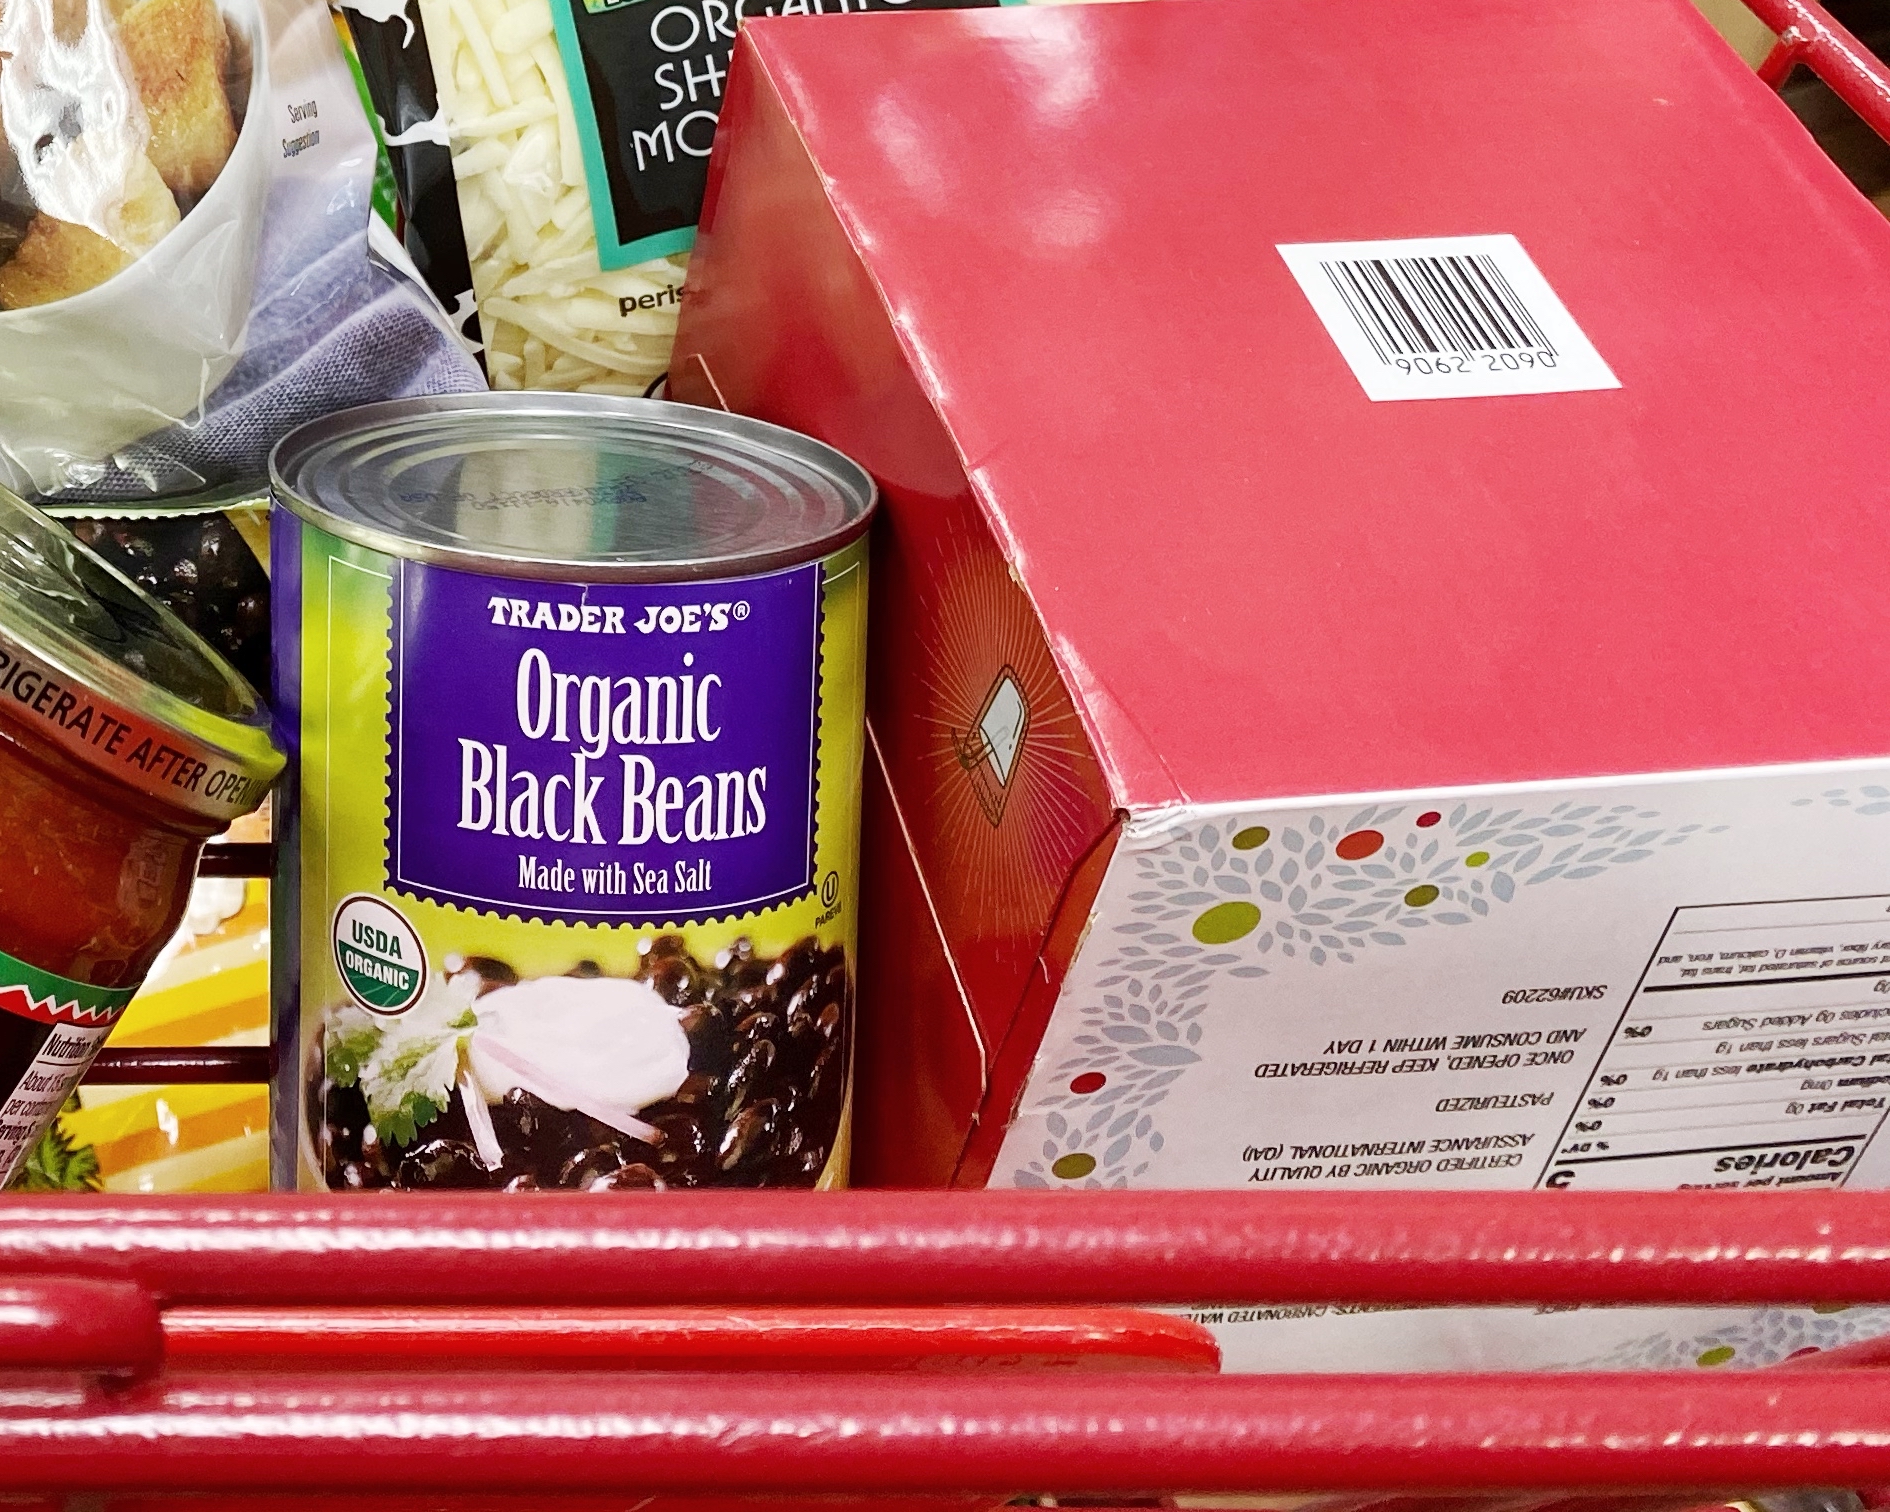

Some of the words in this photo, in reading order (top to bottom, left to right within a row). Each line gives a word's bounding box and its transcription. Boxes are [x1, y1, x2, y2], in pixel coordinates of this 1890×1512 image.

[1395, 355, 1472, 376] 9062
[1484, 351, 1559, 372] 2090
[487, 594, 625, 635] TRADER
[515, 647, 722, 760] Organic
[125, 737, 208, 792] AFTER
[456, 737, 609, 847] Black
[617, 750, 768, 848] Beans
[517, 855, 578, 893] Made
[582, 861, 628, 895] with
[632, 861, 670, 895] Sea
[674, 860, 714, 893] Salt
[351, 918, 403, 960] USDA
[345, 948, 410, 991] ORGANIC
[1502, 985, 1608, 1004] SKU#62209
[1382, 1037, 1448, 1053] WITHIN
[1452, 1032, 1542, 1050] CONSUME
[1546, 1028, 1587, 1044] AND
[1323, 1040, 1364, 1055] DAY
[1368, 1039, 1378, 1053] 1
[1391, 1058, 1440, 1073] KEEP
[1446, 1053, 1520, 1071] OPENED,
[1523, 1049, 1575, 1066] ONCE
[1254, 1060, 1388, 1078] REFRIGERATED
[1436, 1091, 1554, 1112] PASTEURIZED
[1290, 1139, 1425, 1158] INTERNATIONAL
[1428, 1133, 1535, 1153] ASSURANCE
[1242, 1145, 1284, 1162] (QAI)
[1714, 1145, 1857, 1173] Calories
[1326, 1165, 1352, 1178] BY
[1356, 1158, 1432, 1178] ORGANIC
[1437, 1154, 1523, 1173] CERTIFIED
[1248, 1166, 1322, 1181] QUALITY
